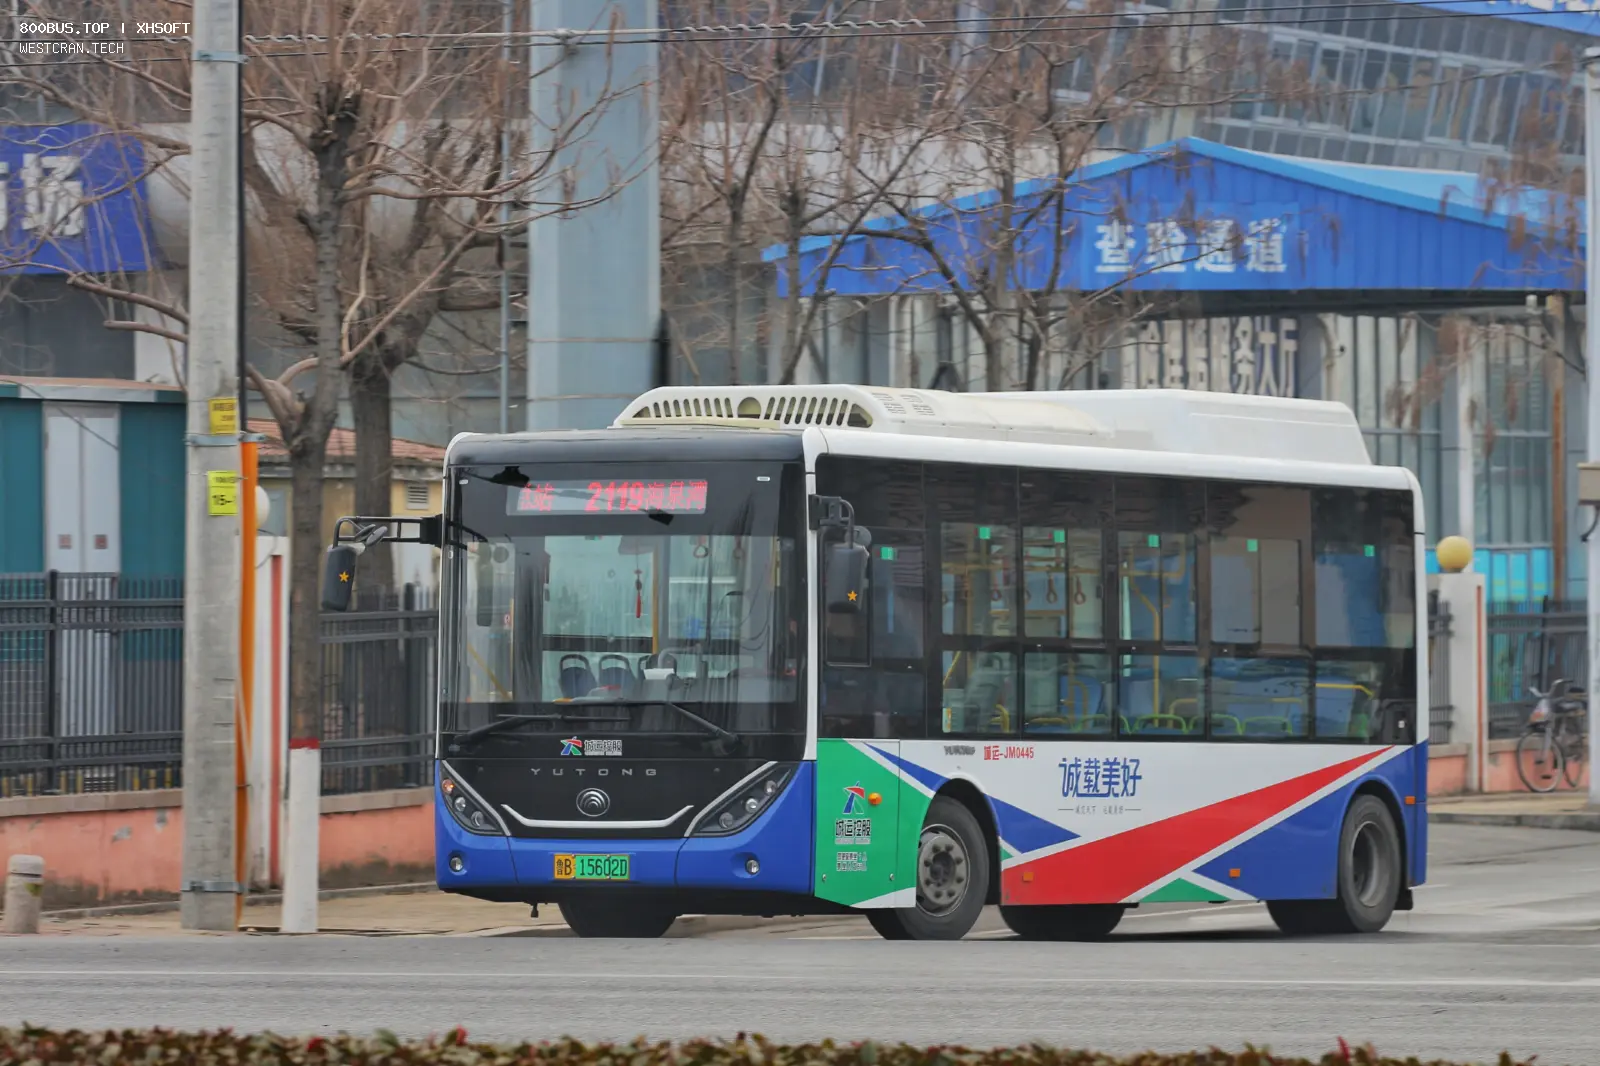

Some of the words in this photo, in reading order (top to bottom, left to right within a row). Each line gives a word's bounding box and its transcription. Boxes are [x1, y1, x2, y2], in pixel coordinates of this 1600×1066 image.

[531, 768, 657, 776] YUTONG
[1058, 757, 1143, 798] 诚载美好
